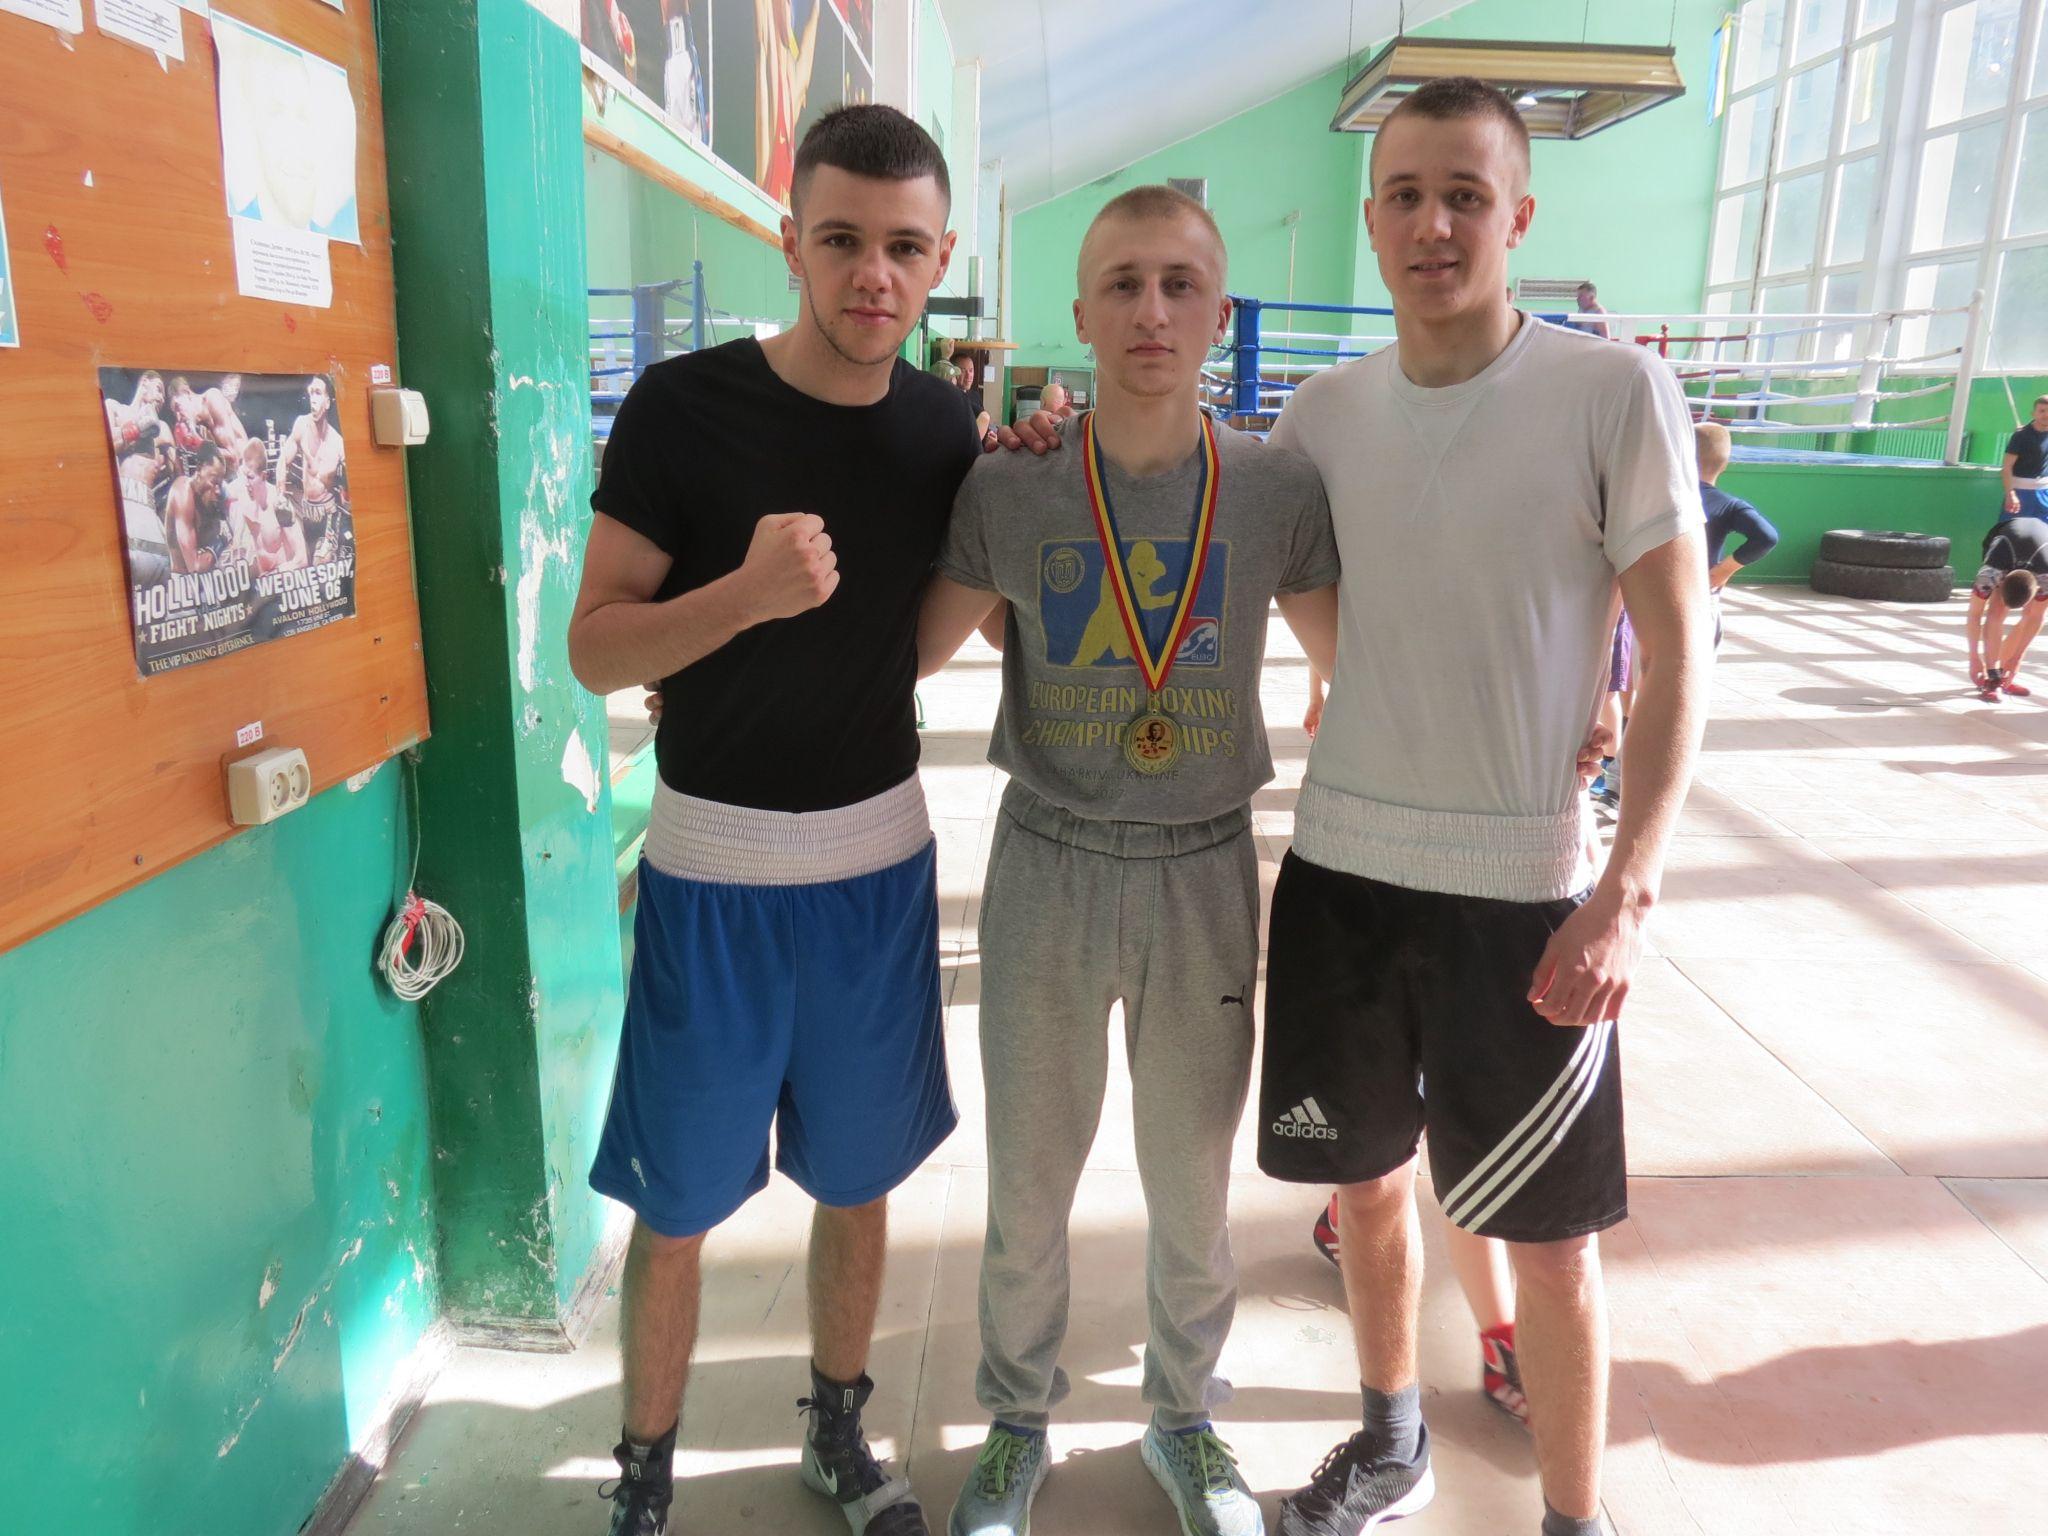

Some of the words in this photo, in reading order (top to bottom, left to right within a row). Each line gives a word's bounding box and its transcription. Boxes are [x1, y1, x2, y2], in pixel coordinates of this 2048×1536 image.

[136, 559, 251, 626] HOLLYWOOD
[255, 559, 354, 598] WEDNESDAY,
[272, 610, 306, 626] AVALON
[308, 597, 348, 616] HOLLYWOOD
[278, 584, 322, 613] JUNE
[325, 580, 341, 601] 06
[150, 615, 199, 644] FIGHT
[202, 603, 246, 632] NIGHTS
[148, 657, 170, 672] THE
[168, 654, 182, 667] VIP
[181, 645, 217, 664] BOXING
[1029, 681, 1136, 714] EUROPEAN
[1272, 1121, 1338, 1140] adidas
